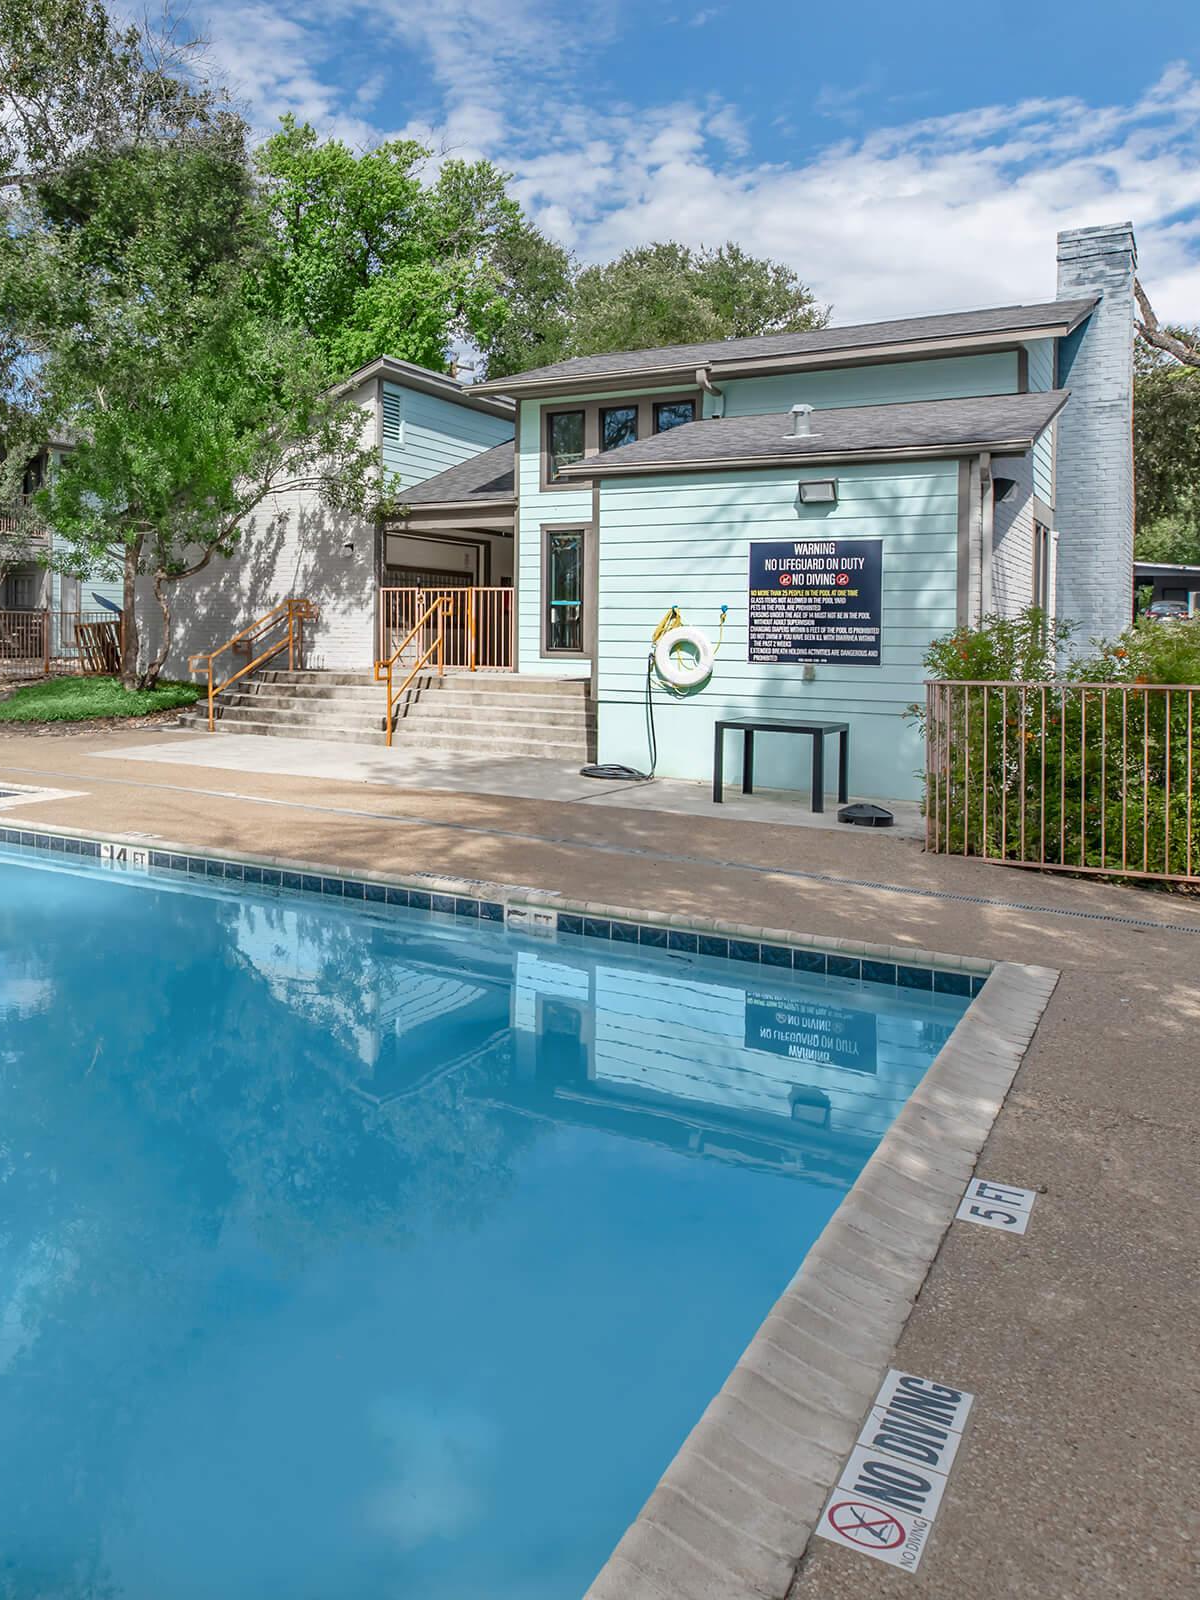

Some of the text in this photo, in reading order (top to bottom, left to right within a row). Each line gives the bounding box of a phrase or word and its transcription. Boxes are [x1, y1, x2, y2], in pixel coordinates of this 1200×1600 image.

[794, 542, 835, 555] WARNING
[765, 557, 865, 571] NO LIFEGUARD ON DUTY
[792, 573, 836, 585] NO DIVING
[969, 1182, 1025, 1225] 5 FT
[853, 1376, 962, 1514] NO DIVING
[900, 1519, 928, 1568] NO DIVING
